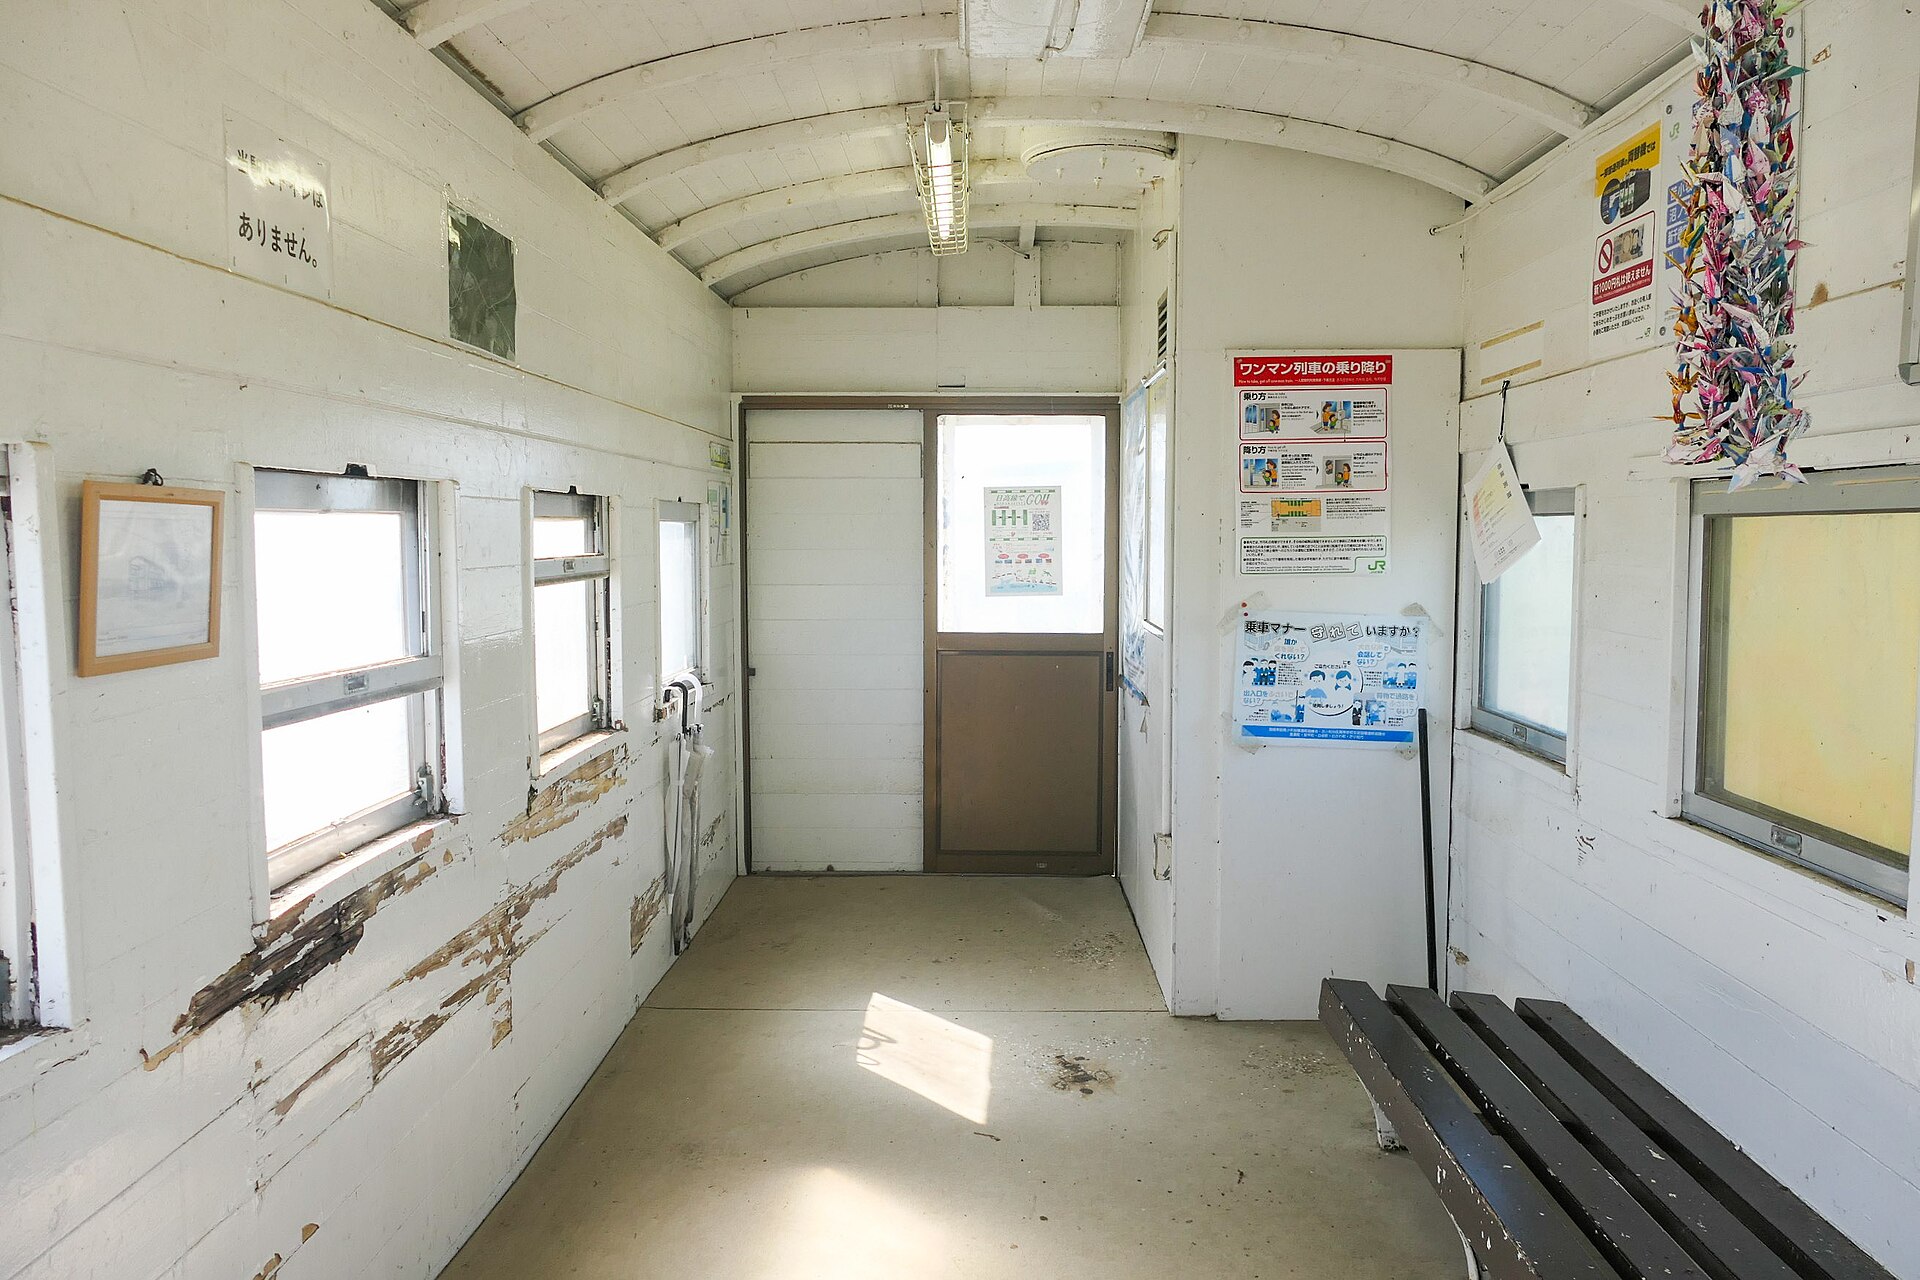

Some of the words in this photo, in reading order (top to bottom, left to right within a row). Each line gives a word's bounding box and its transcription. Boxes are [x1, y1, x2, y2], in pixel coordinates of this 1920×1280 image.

[238, 211, 318, 269] ありません。
[1239, 361, 1387, 376] ワンマン列車の乗り降り
[1243, 393, 1266, 401] 乗り方
[1243, 446, 1266, 454] 降り方
[1368, 561, 1386, 571] JR
[1244, 621, 1306, 634] 乗車マナー
[1311, 623, 1360, 639] 守れて
[1366, 626, 1419, 638] いますか?
